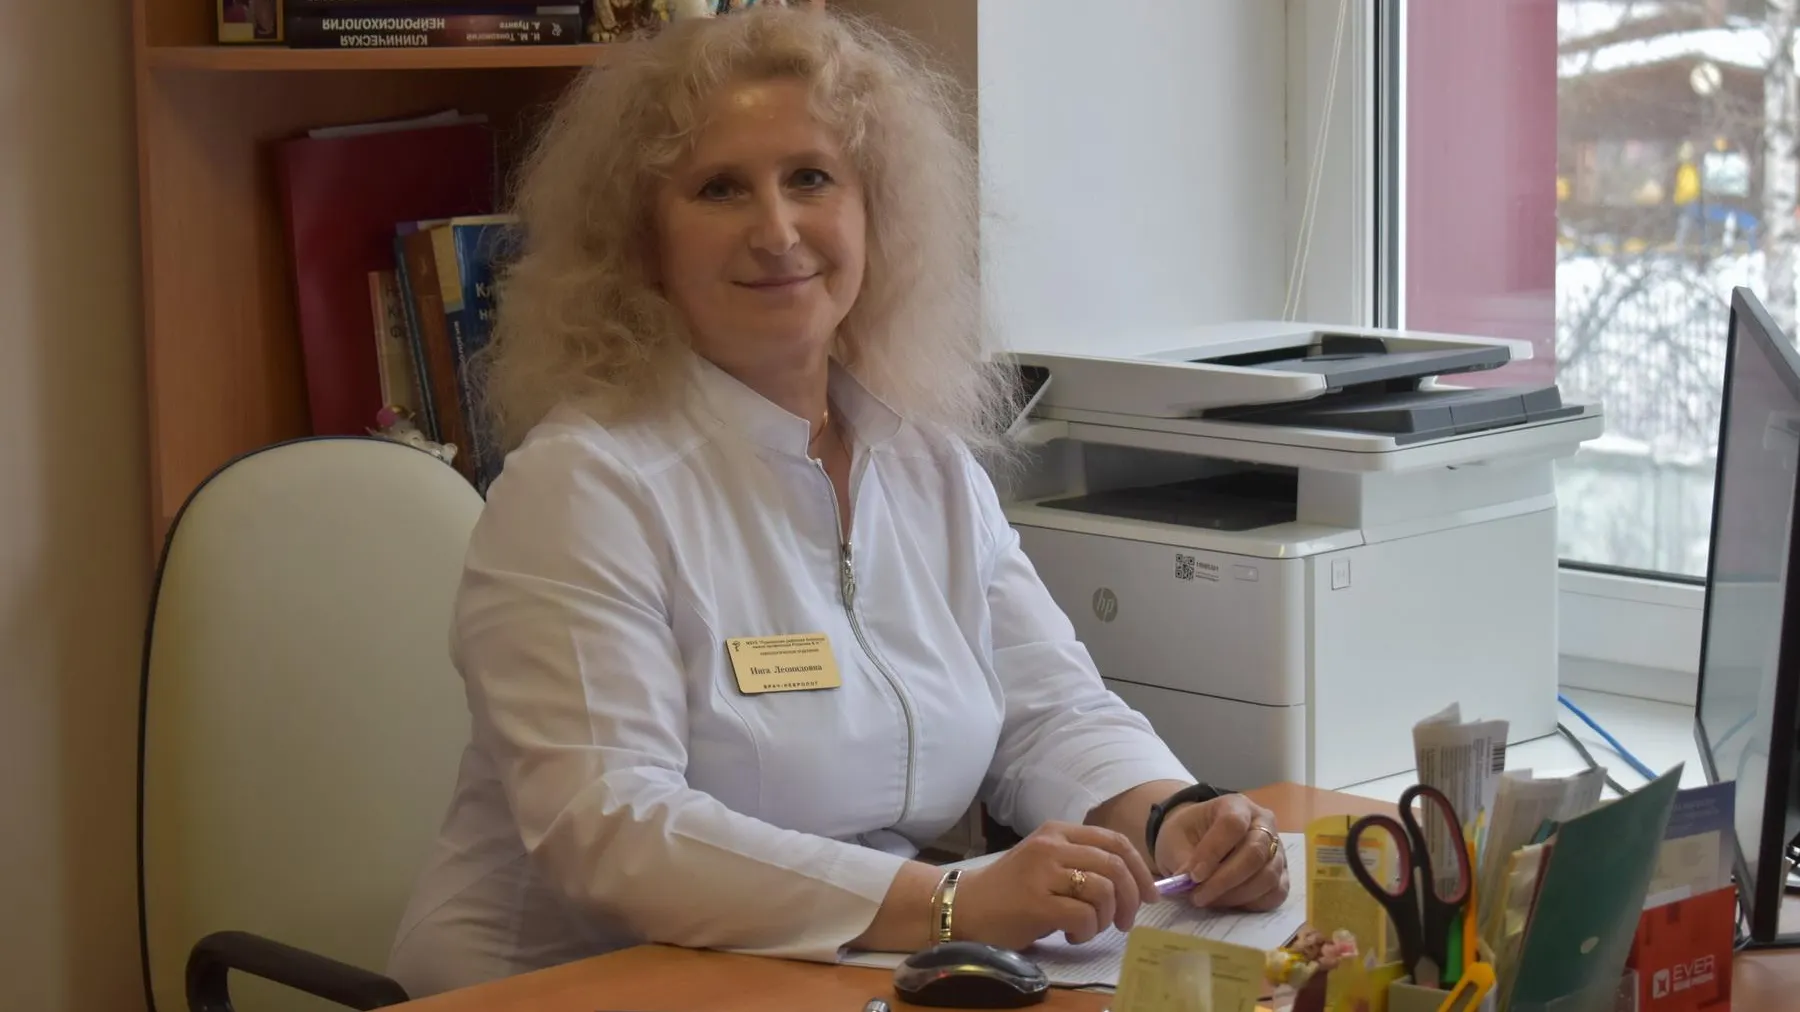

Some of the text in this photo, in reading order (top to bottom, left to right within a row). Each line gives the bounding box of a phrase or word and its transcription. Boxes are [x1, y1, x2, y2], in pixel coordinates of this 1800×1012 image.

[322, 17, 445, 31] НЕЙРОПСИХОЛОГИЯ
[340, 34, 428, 47] КЛИНИЧЕСКАЯ
[1096, 588, 1115, 624] hp
[750, 664, 823, 676] Инга Леонидовна
[1673, 954, 1715, 980] EVER
